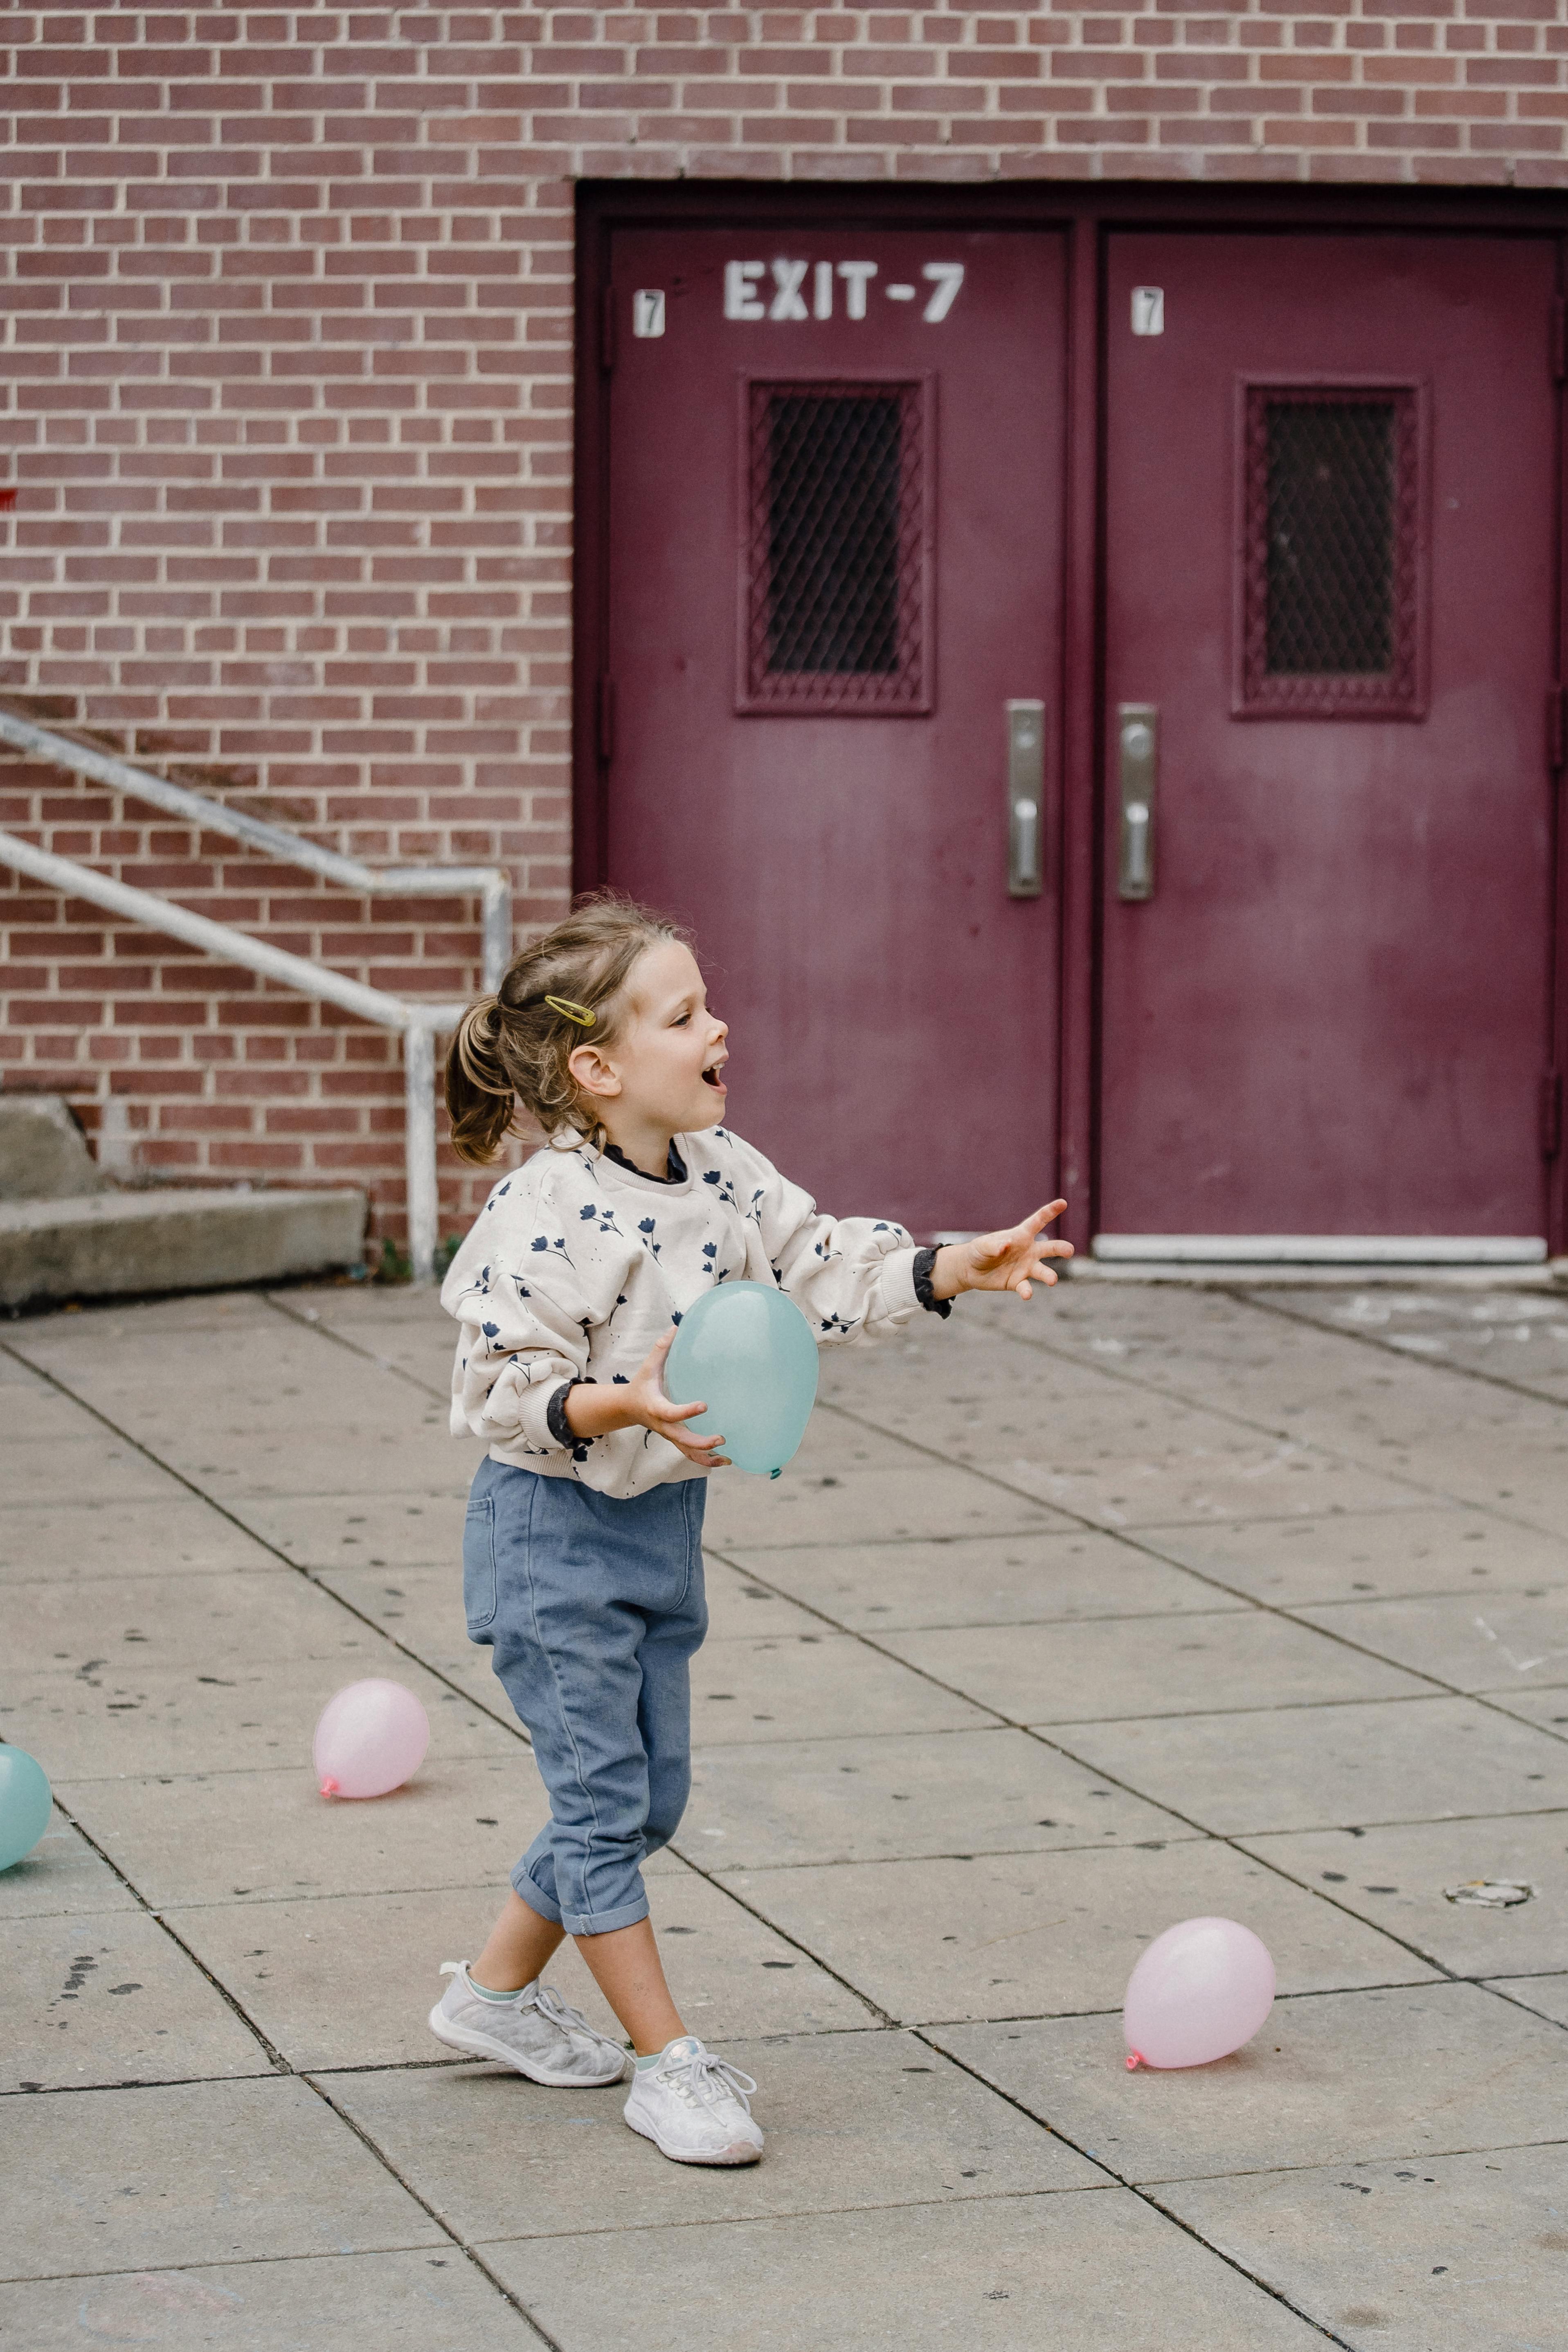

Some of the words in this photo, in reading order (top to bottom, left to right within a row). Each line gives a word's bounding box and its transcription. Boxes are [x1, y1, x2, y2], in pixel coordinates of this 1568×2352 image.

[645, 291, 658, 329] 7
[724, 259, 965, 323] EXIT-7
[1144, 290, 1157, 327] 7
